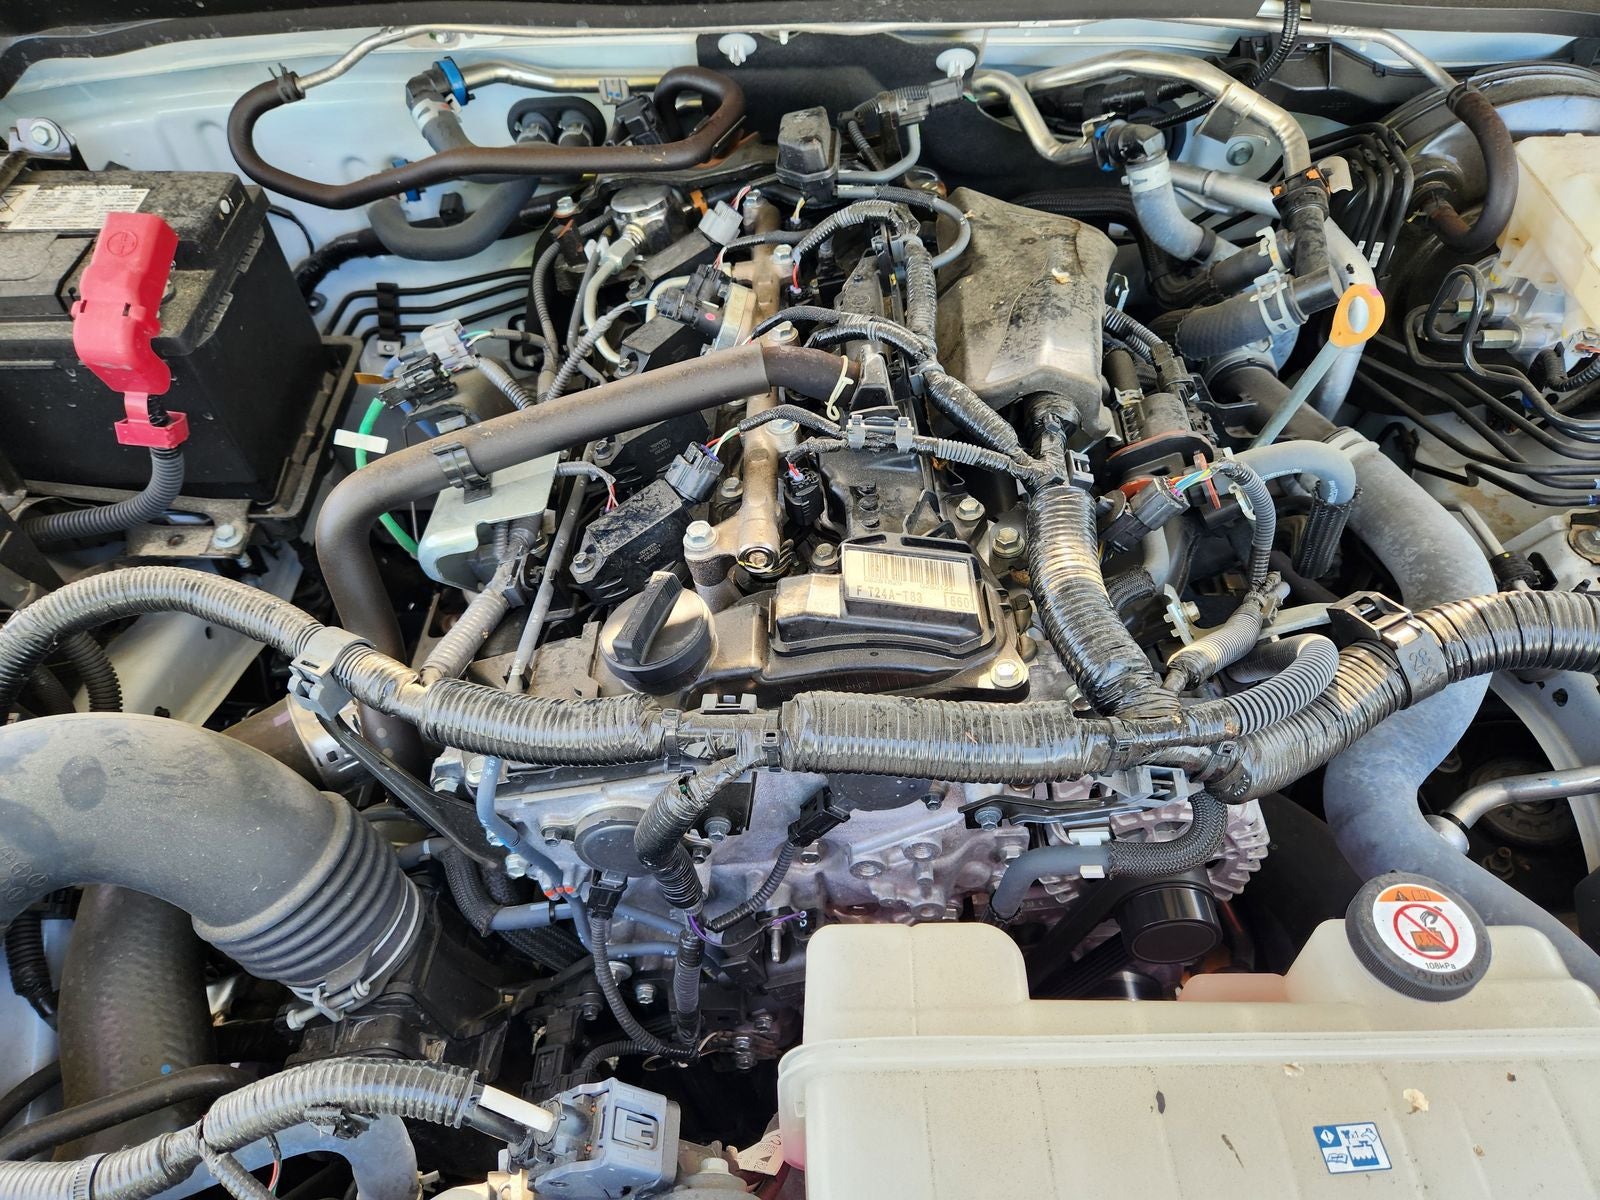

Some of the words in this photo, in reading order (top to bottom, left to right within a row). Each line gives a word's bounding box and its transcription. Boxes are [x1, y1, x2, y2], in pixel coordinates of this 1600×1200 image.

[856, 584, 862, 597] F
[1408, 647, 1432, 672] 28
[1425, 962, 1457, 970] 108kPa
